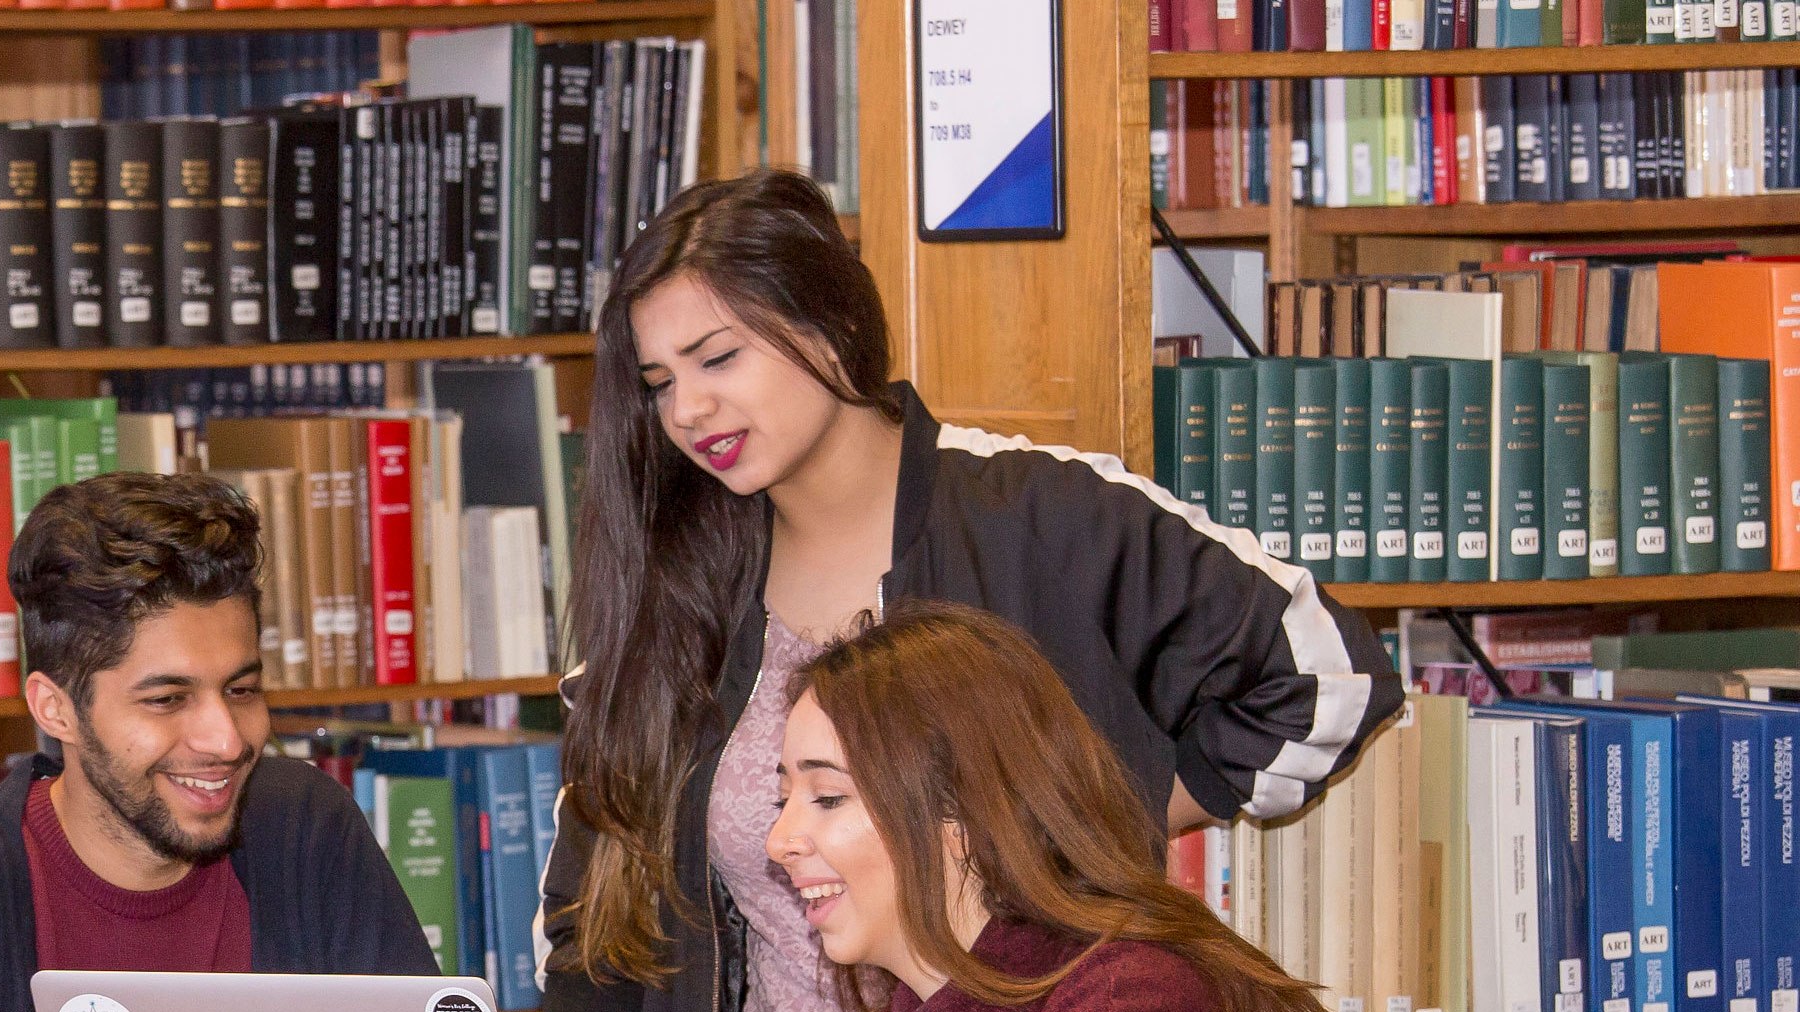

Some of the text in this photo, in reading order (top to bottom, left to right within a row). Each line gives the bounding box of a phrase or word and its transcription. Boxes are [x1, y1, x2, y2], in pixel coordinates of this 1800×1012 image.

[1723, 0, 1731, 21] ART
[1648, 16, 1672, 25] ART
[1682, 9, 1691, 32] ART
[1702, 8, 1710, 32] ART
[1750, 6, 1759, 30] ART
[1782, 7, 1791, 31] ART
[927, 19, 966, 36] DEWEY
[929, 70, 971, 86] 708.5 H4
[930, 101, 938, 110] to
[931, 125, 971, 141] 709 M38
[1690, 526, 1711, 535] ART
[1742, 530, 1763, 540] ART
[1266, 541, 1288, 550] ART
[1306, 542, 1328, 551] ART
[1342, 539, 1364, 548] ART
[1382, 539, 1403, 548] ART
[1420, 541, 1440, 550] ART
[1464, 541, 1484, 550] ART
[1515, 538, 1536, 546] ART
[1563, 539, 1584, 547] ART
[1641, 537, 1662, 546] ART
[1594, 547, 1615, 557] ART
[1569, 734, 1578, 841] MUSEO POLDI PEZZOLI
[1741, 740, 1750, 866] MUSEO POLDI PEZZOLI
[1783, 736, 1792, 863] MUSEO POLDI PEZZOLI
[1642, 935, 1665, 945] ART
[1606, 941, 1629, 951] ART
[1693, 979, 1712, 989] ART
